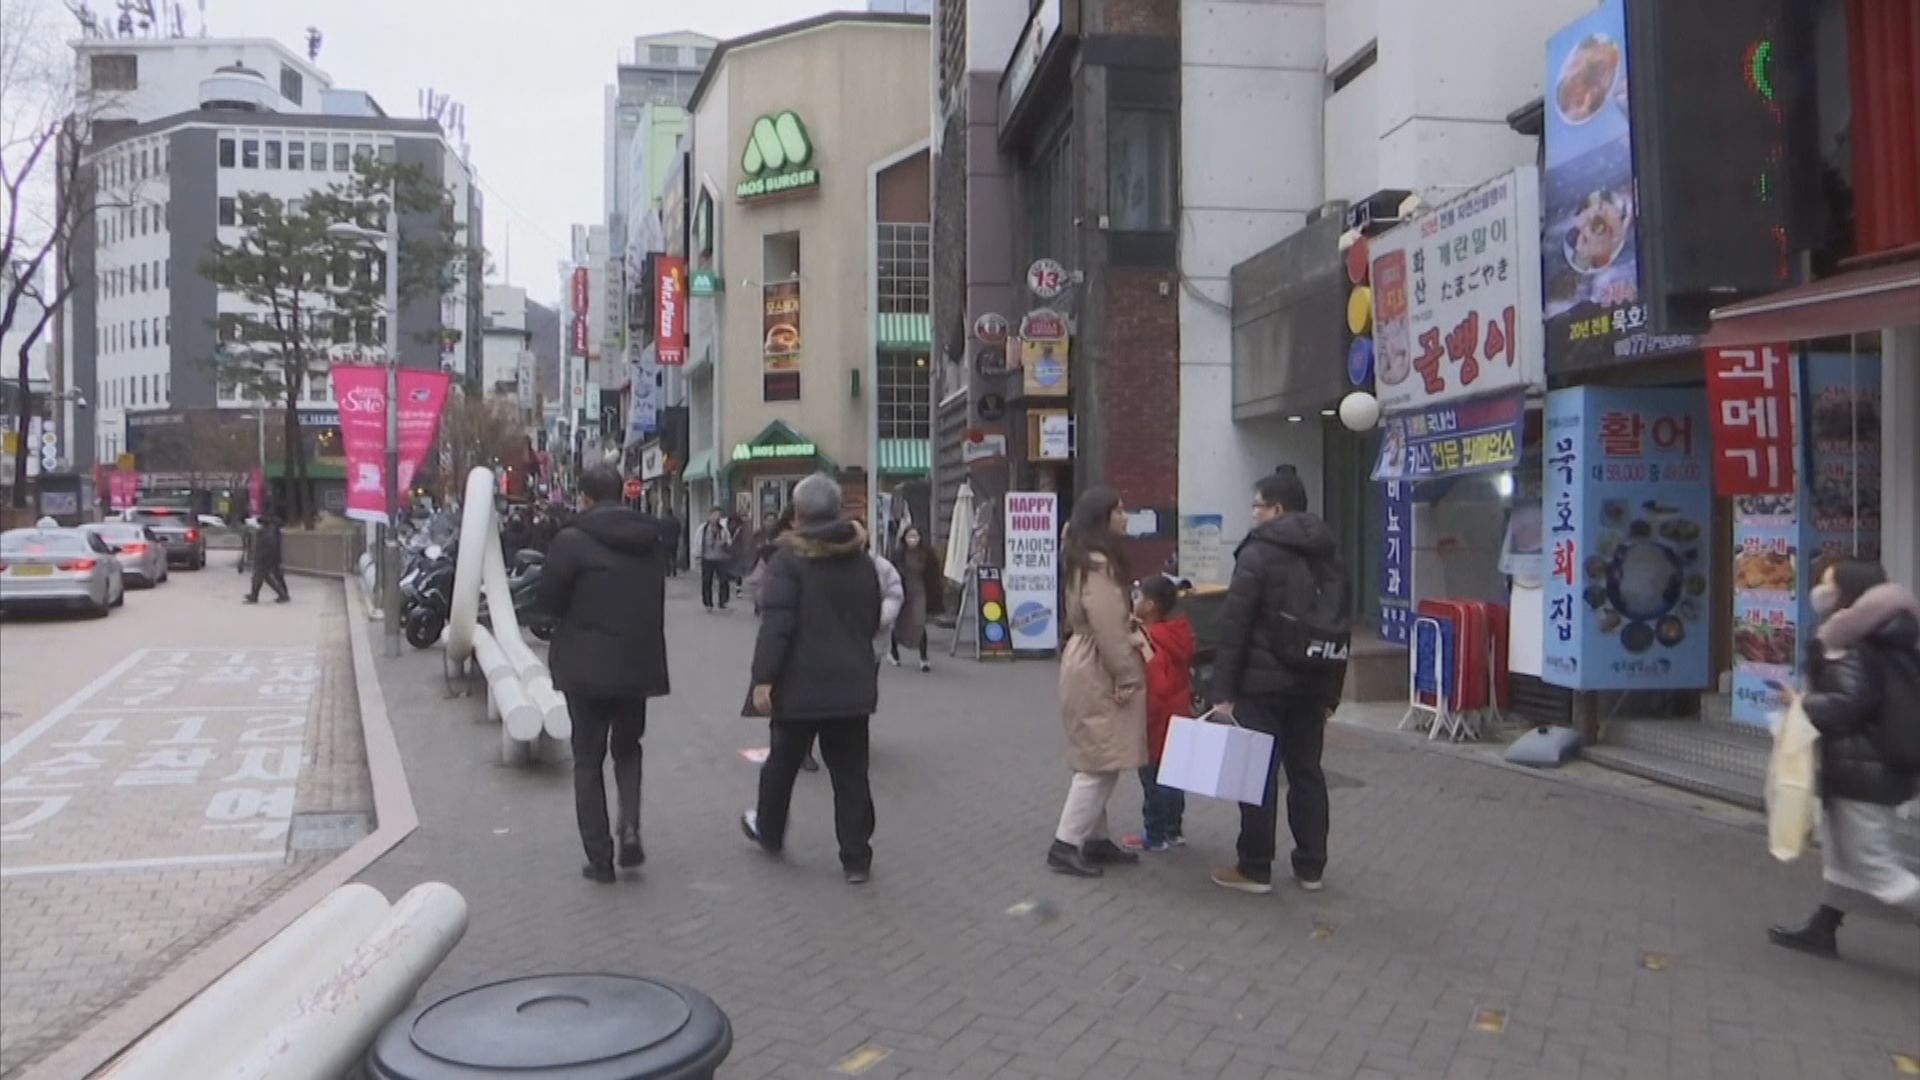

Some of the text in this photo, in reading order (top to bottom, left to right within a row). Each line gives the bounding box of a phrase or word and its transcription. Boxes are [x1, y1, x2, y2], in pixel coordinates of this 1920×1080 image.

[736, 169, 816, 196] MOS BURGER
[1437, 216, 1507, 267] 계란말이
[1036, 271, 1059, 289] 13
[1440, 258, 1508, 302] たまごやき
[660, 274, 675, 338] Mr.Pizza
[1413, 305, 1515, 395] 골뱅이
[1427, 410, 1456, 432] 국내산
[1599, 411, 1694, 457] 활어
[1718, 348, 1780, 488] 과메기
[752, 446, 774, 457] MOS
[775, 444, 815, 457] BURGER
[1408, 429, 1515, 474] 카스 전문 판매업소
[1008, 497, 1055, 513] HAPPY
[1011, 516, 1052, 531] HOUR
[1386, 480, 1401, 596] 비뇨기과
[1012, 553, 1052, 569] 주문시
[1306, 640, 1348, 659] FILA
